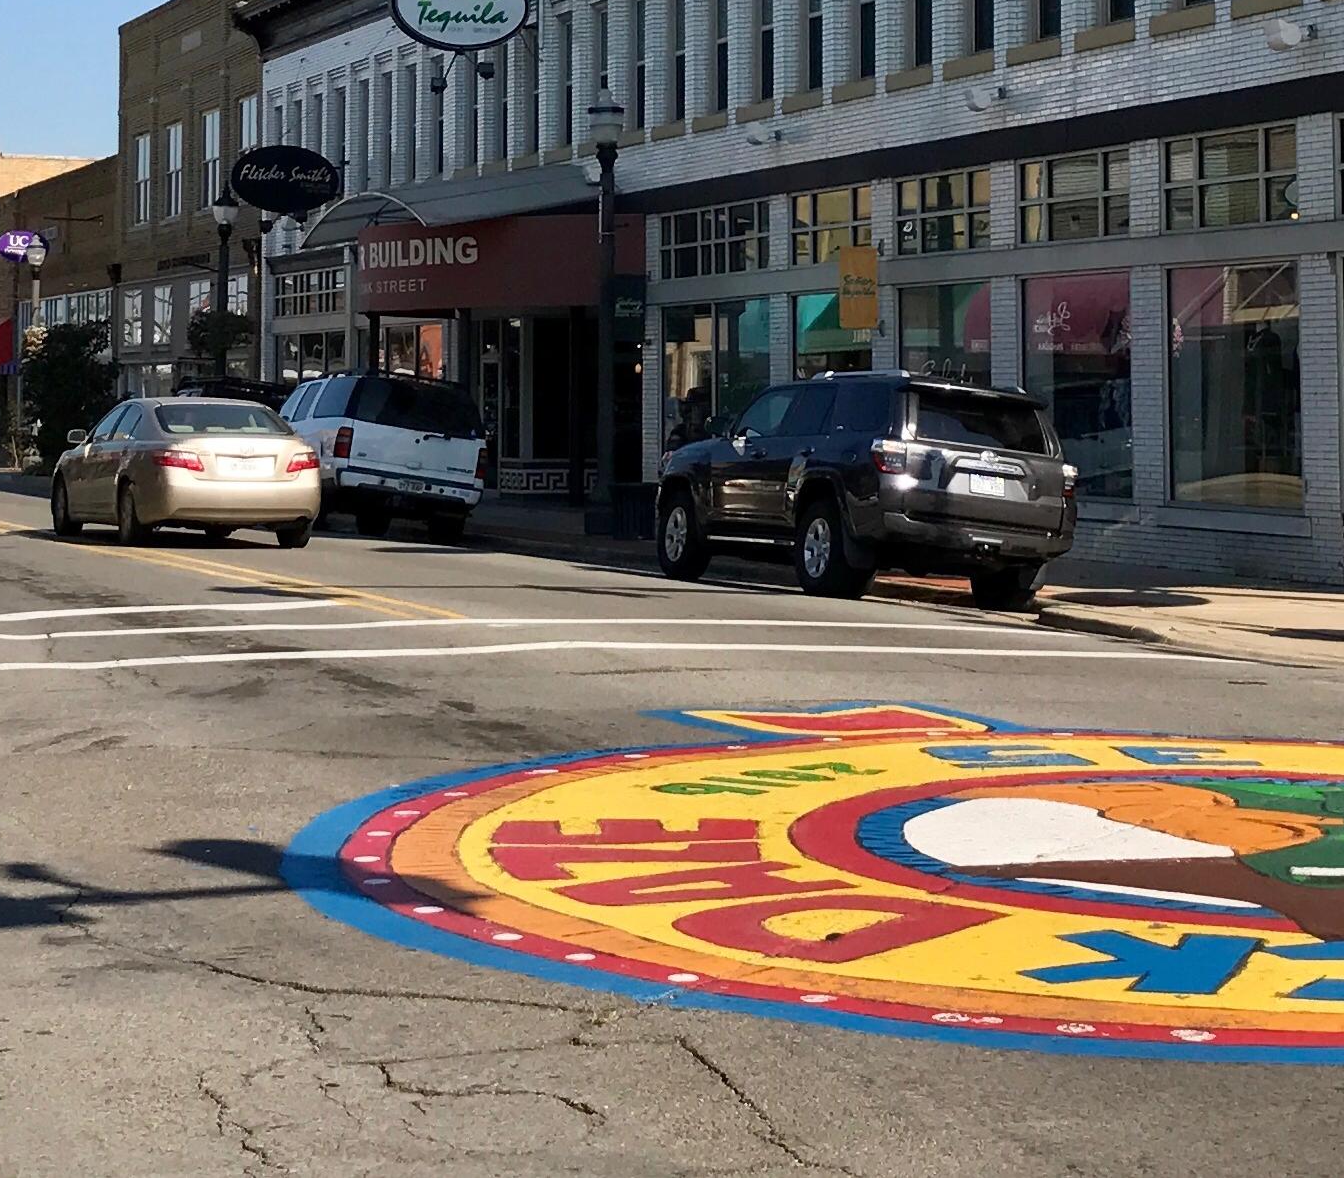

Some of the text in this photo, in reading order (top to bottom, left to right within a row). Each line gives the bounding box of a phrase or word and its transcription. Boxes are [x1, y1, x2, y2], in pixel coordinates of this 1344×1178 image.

[417, 1, 509, 33] Tequila
[369, 236, 478, 269] BUILDING
[376, 279, 427, 294] STREET
[490, 818, 1011, 964] DAZE
